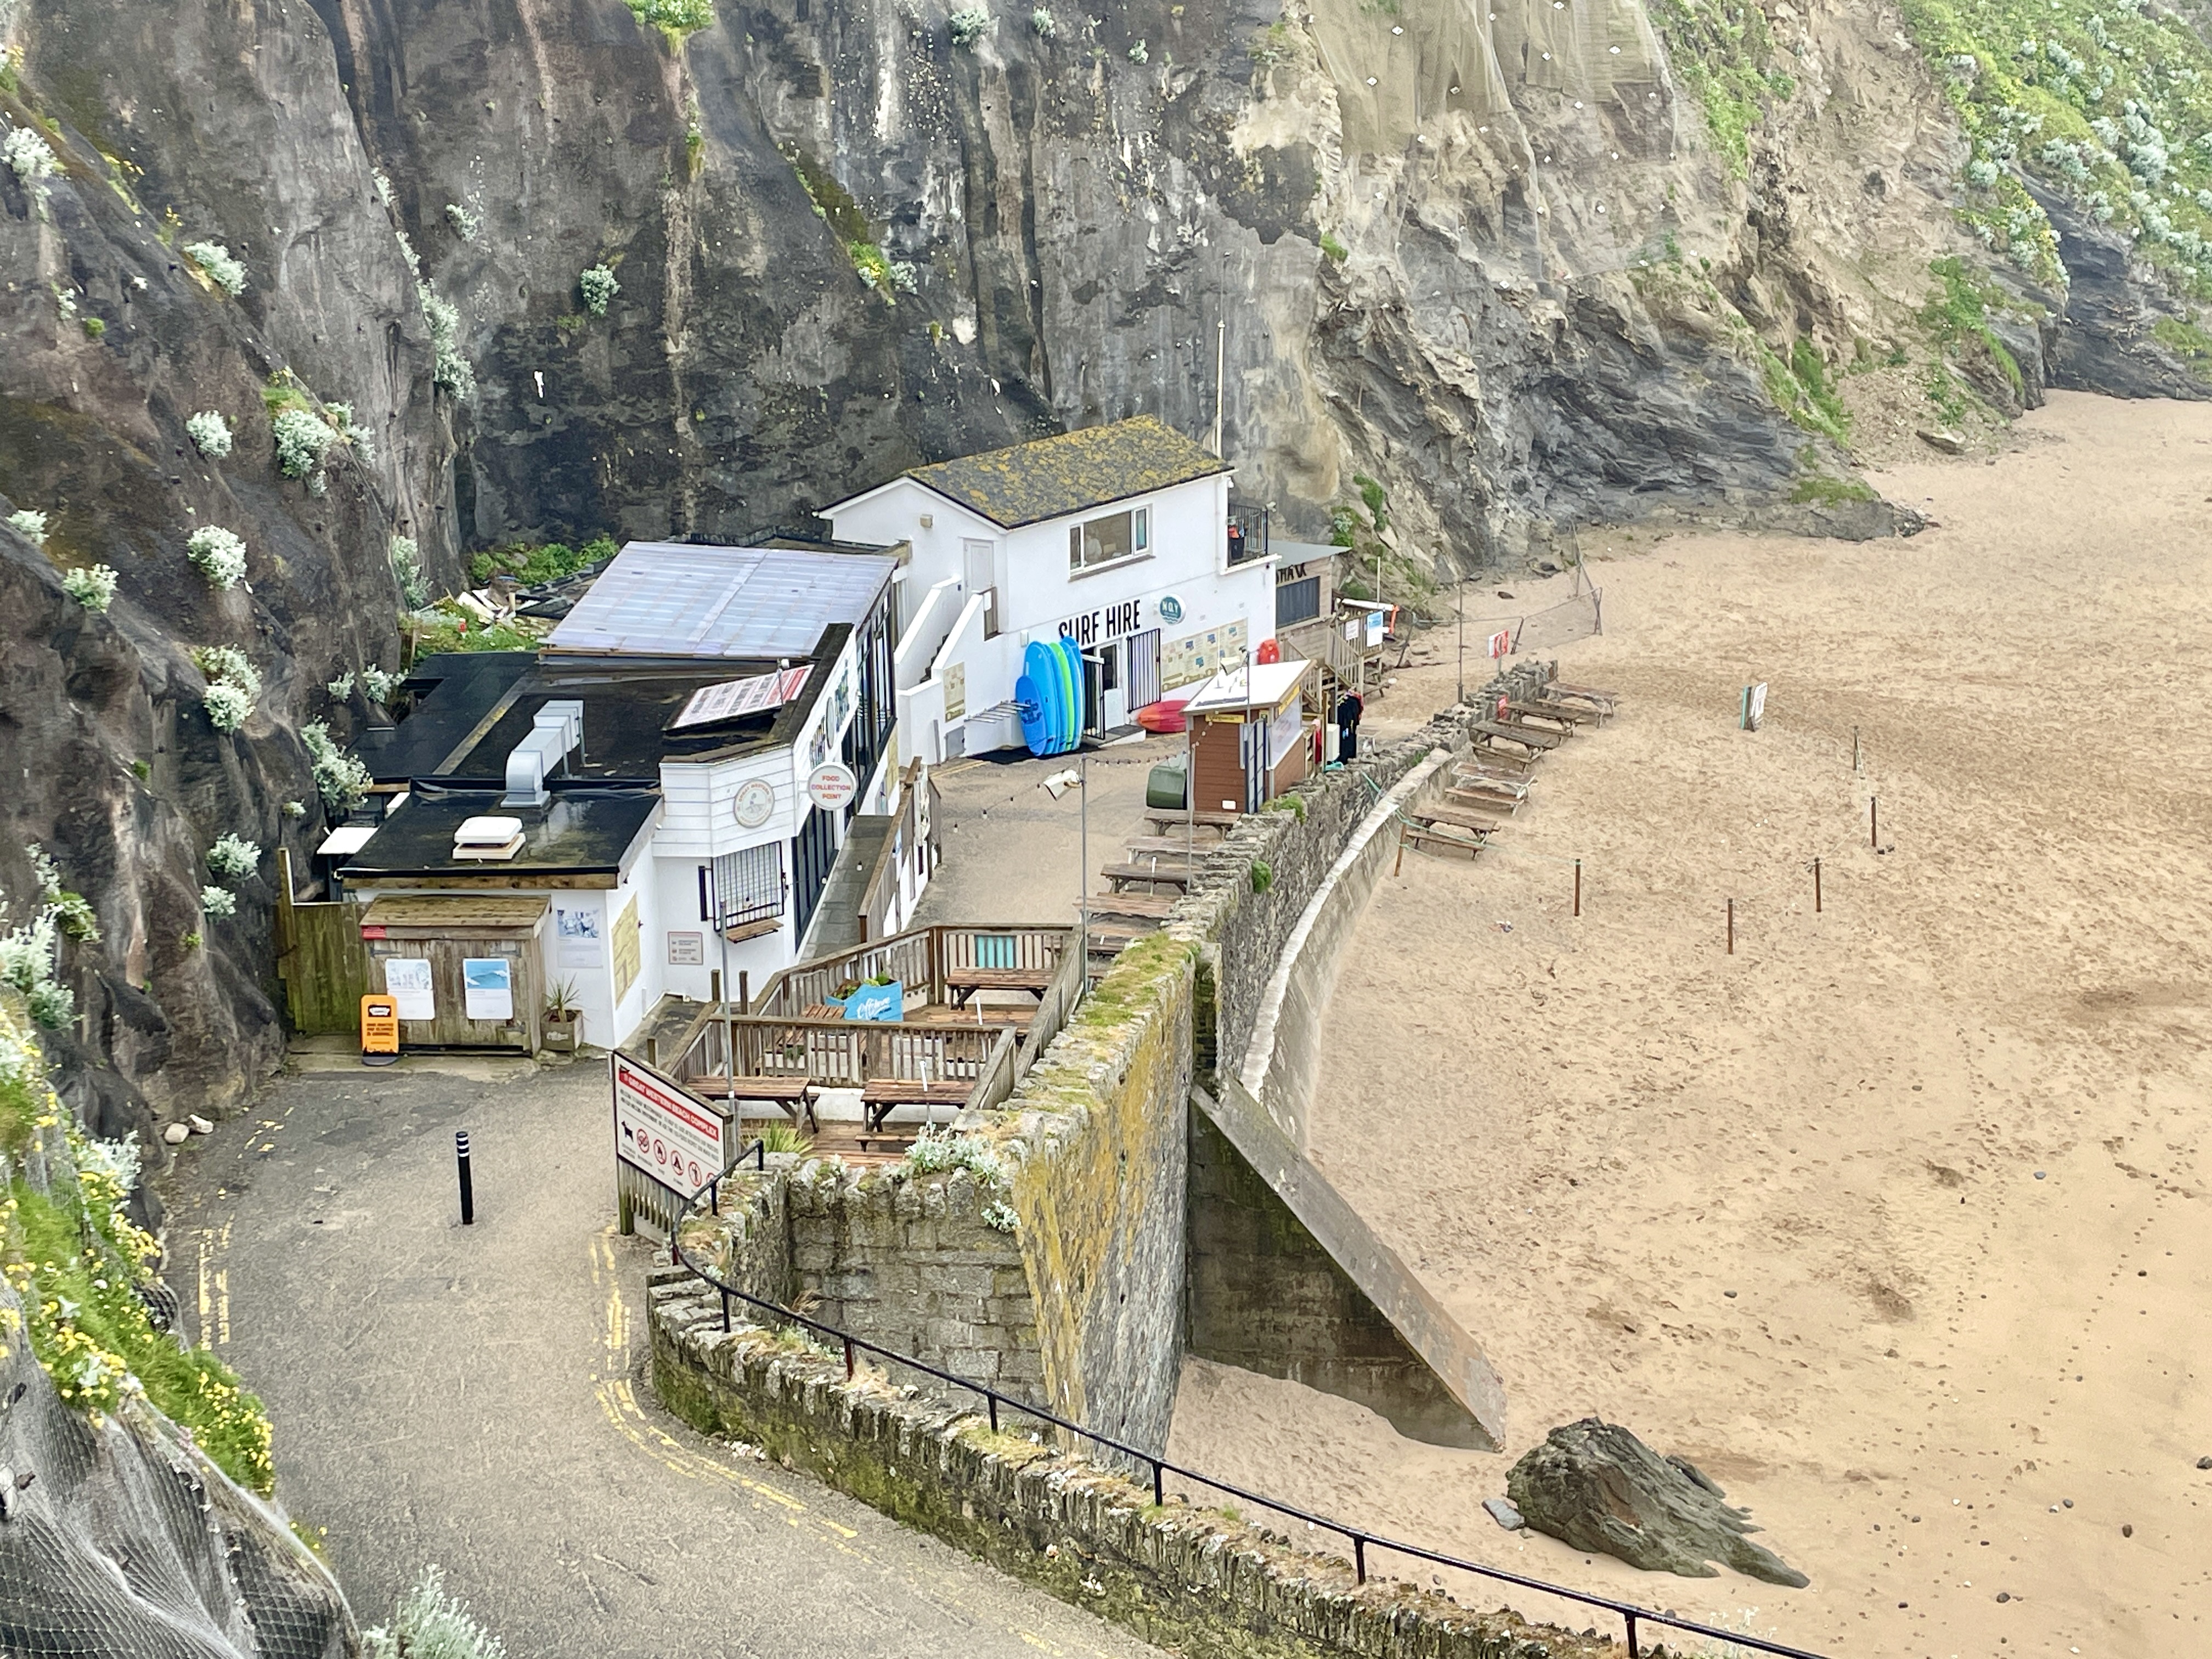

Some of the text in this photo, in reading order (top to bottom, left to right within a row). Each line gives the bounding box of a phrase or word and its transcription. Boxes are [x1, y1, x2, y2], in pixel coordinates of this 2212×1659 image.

[1162, 601, 1178, 613] NQY
[1059, 599, 1141, 646] SURF HIRE
